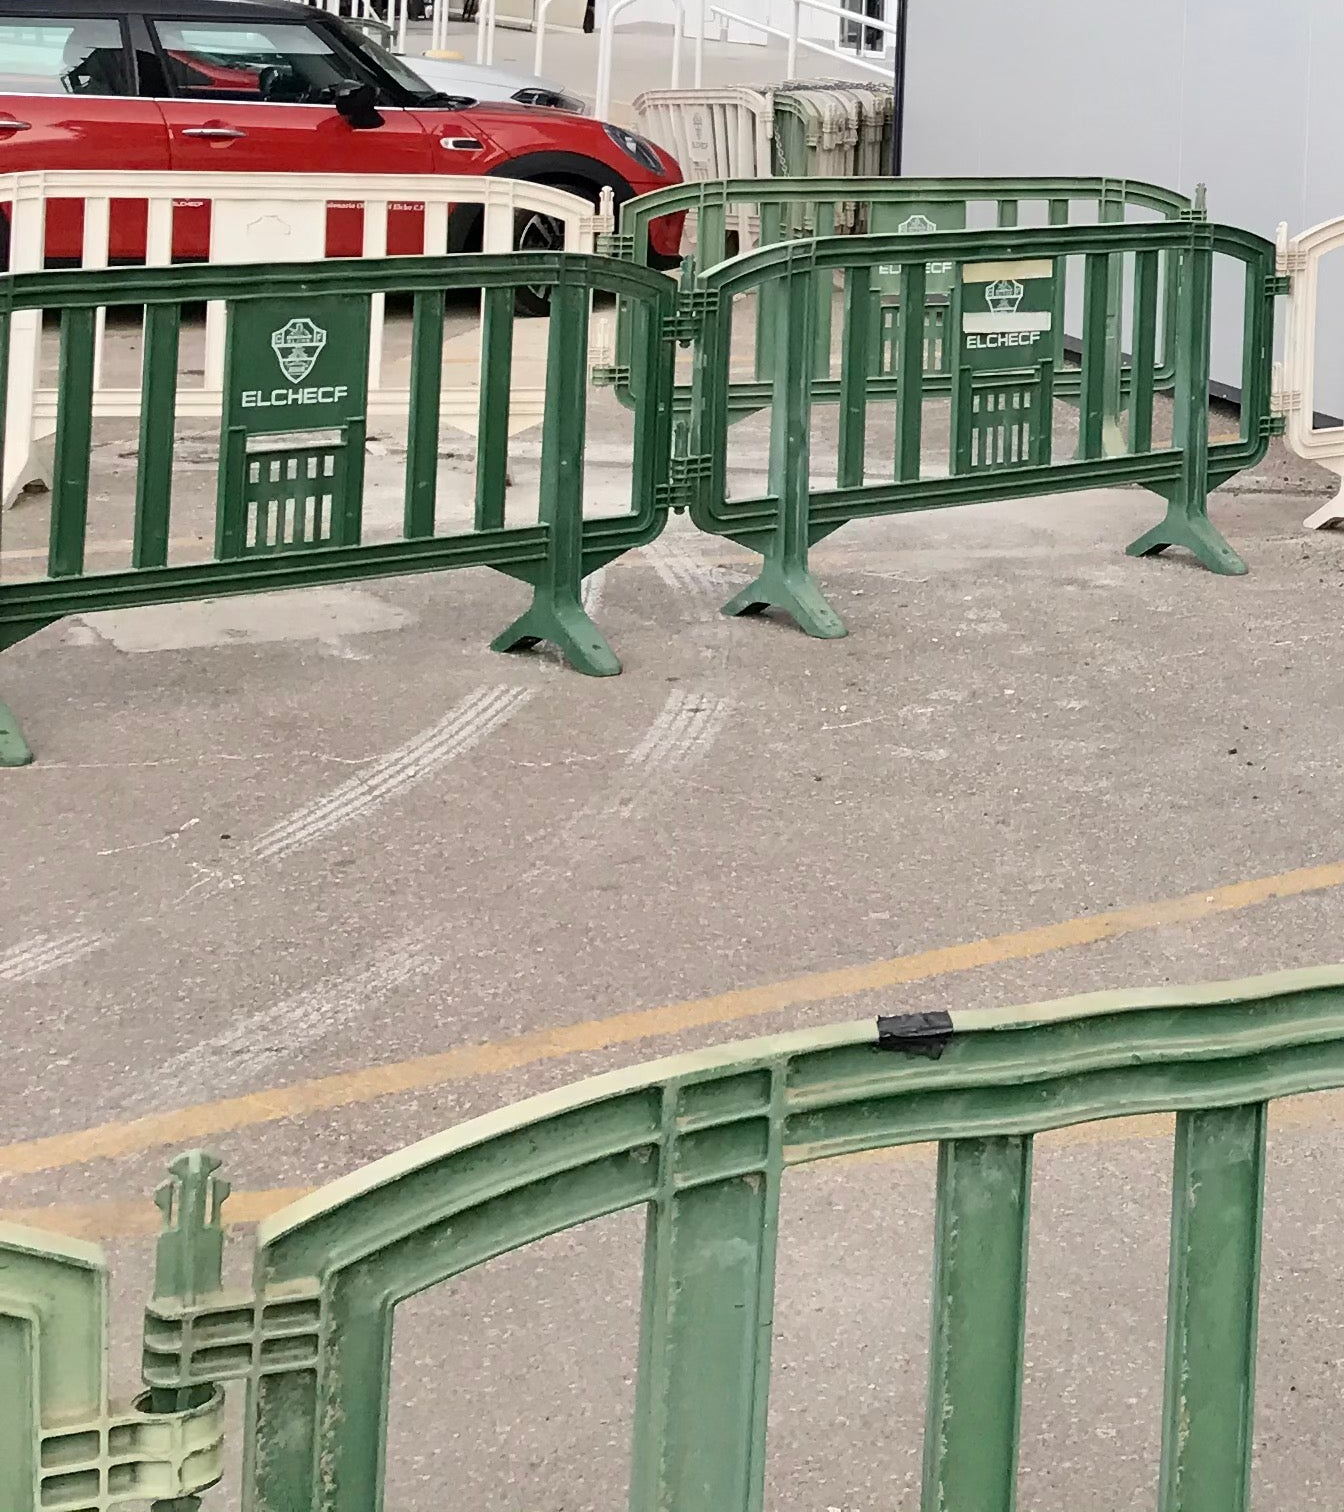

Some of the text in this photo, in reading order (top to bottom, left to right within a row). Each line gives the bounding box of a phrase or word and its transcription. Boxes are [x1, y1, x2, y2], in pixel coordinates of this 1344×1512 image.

[878, 262, 952, 275] ELECF
[966, 331, 1041, 349] ELCHECF
[241, 385, 348, 408] ELCHECF
